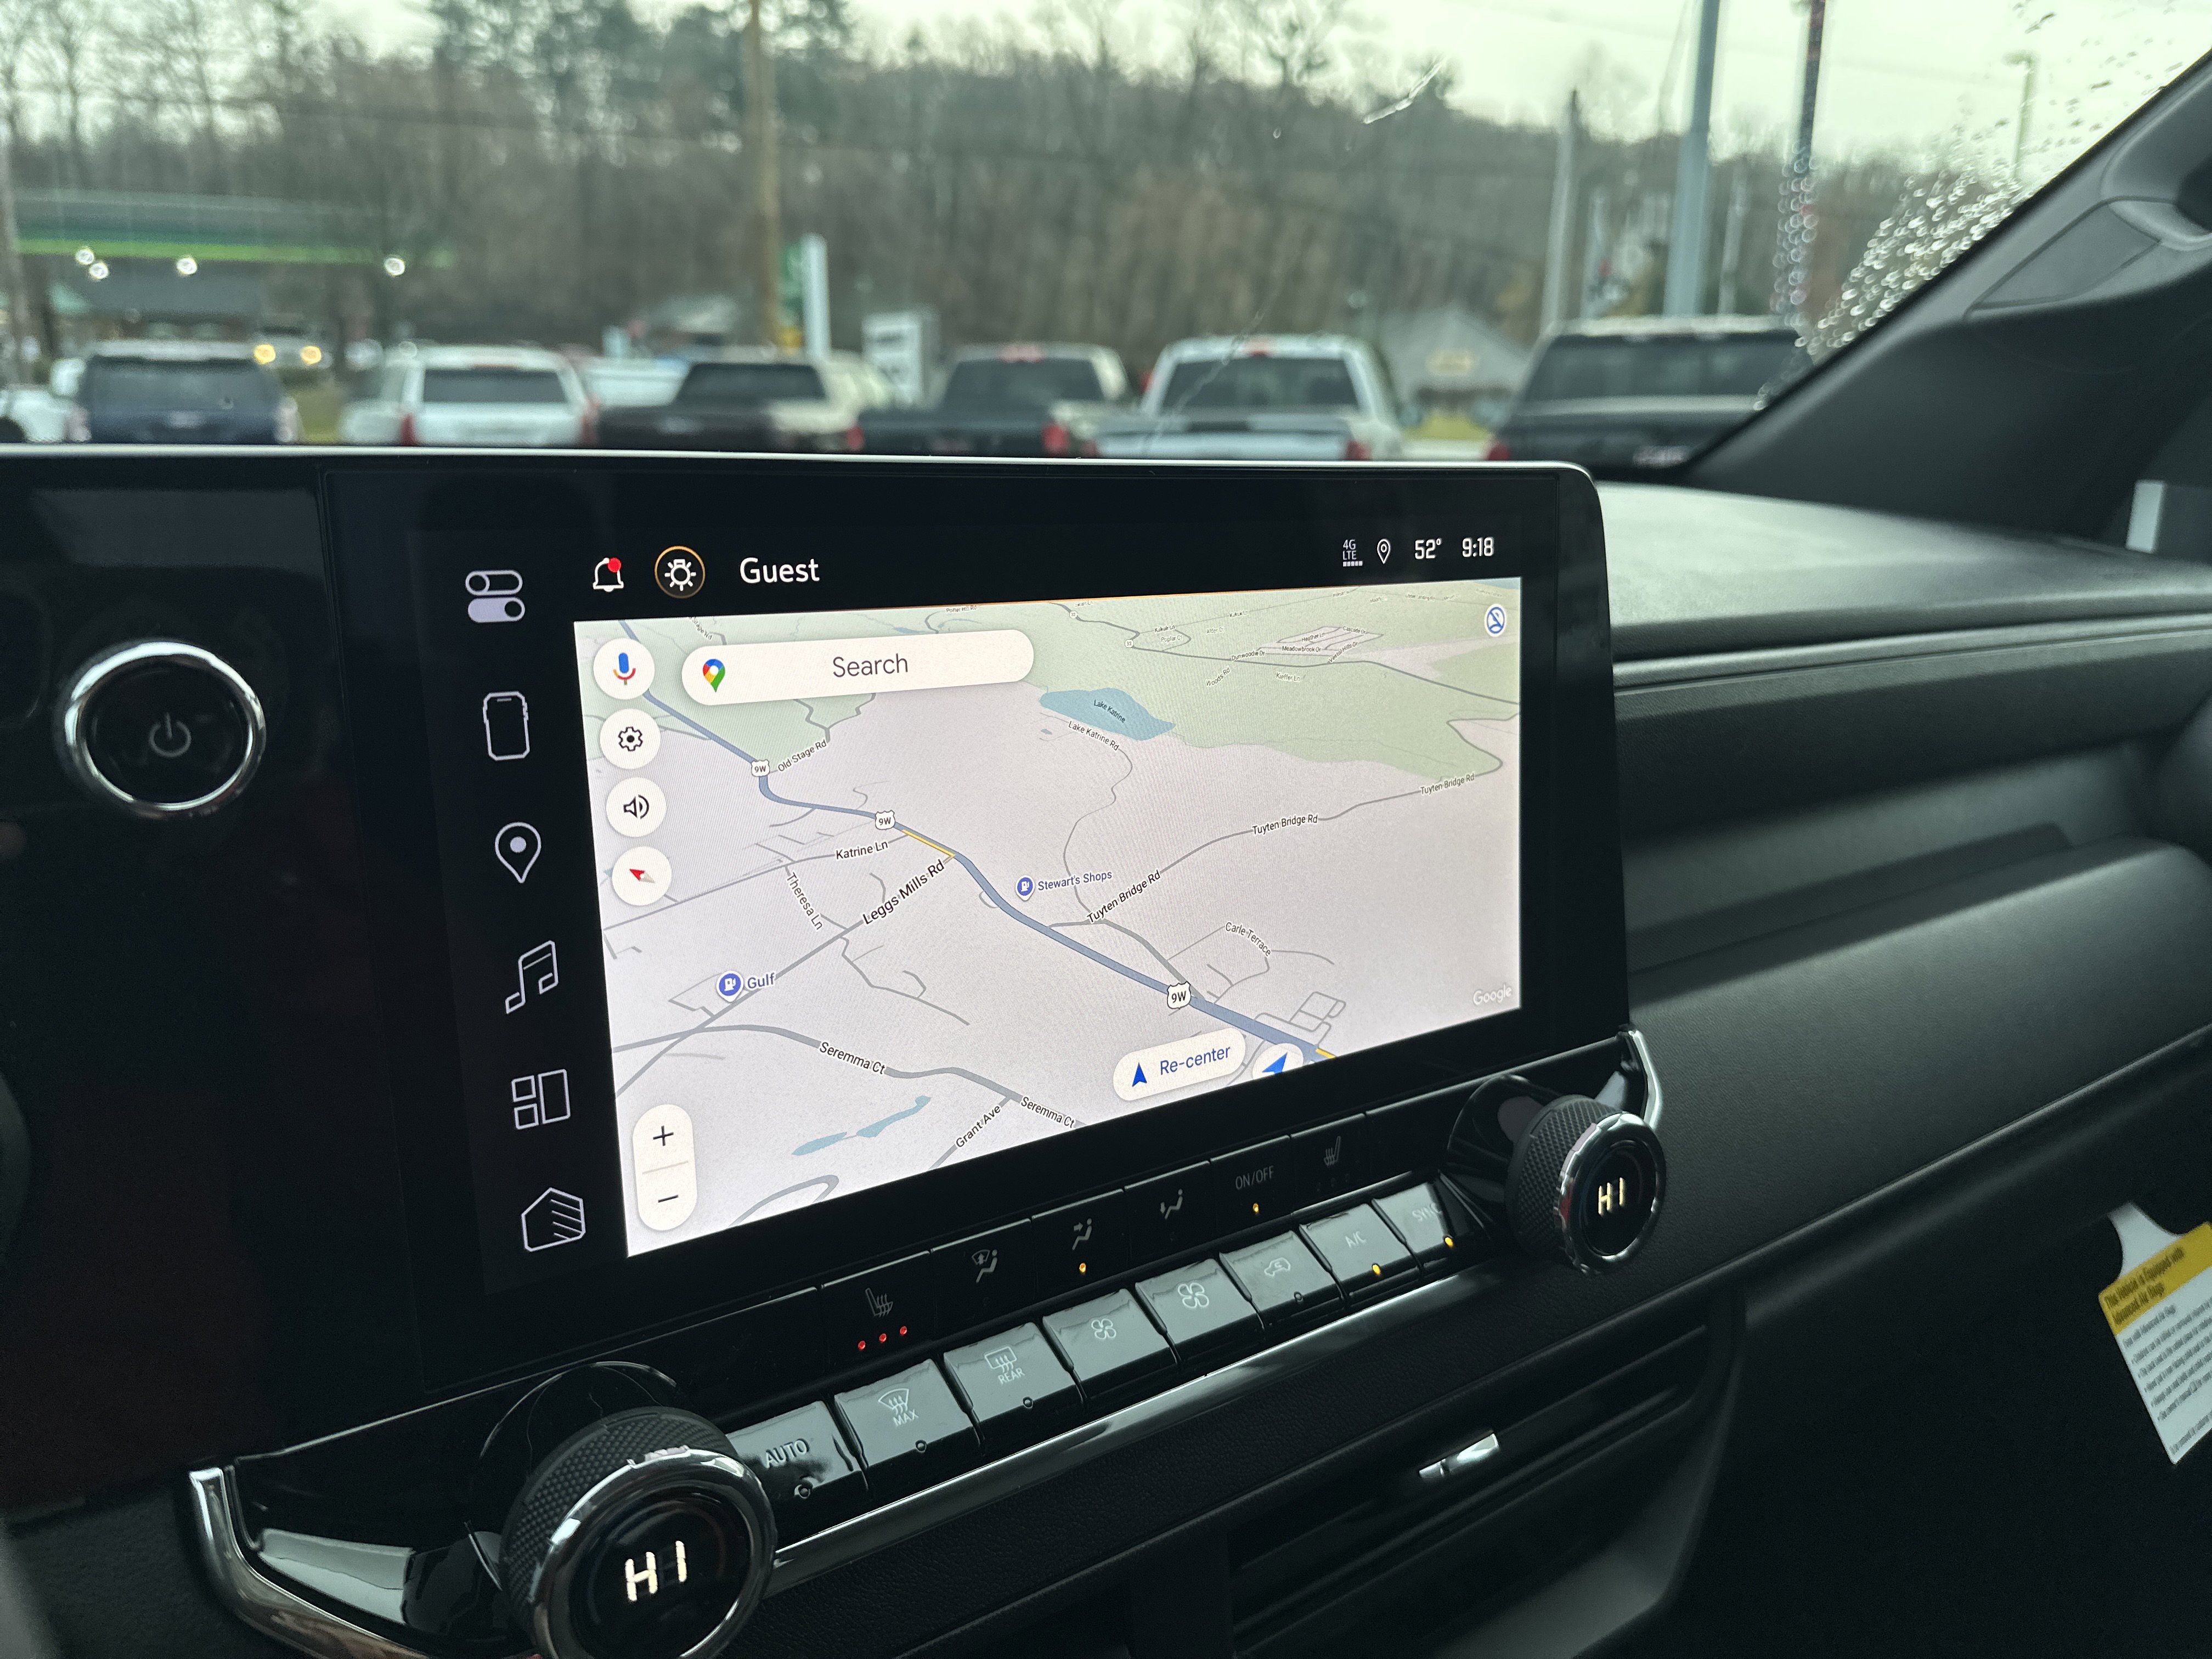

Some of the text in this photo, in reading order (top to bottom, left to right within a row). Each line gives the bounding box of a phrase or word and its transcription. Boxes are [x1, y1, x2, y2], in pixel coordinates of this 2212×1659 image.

[1342, 539, 1356, 550] 4G
[1342, 550, 1357, 560] LTE
[1415, 538, 1442, 560] 52°
[1462, 537, 1495, 557] 9:18
[740, 557, 820, 584] Guest
[833, 654, 909, 679] Search
[1231, 651, 1259, 661] Dunwoodie
[1206, 667, 1231, 686] Woods Rd
[1276, 672, 1293, 681] Kieffer
[1094, 699, 1125, 723] Lake Katrine
[1068, 721, 1120, 751] Lake Katrine Rd
[778, 739, 827, 772] Old Stage Rd
[1420, 773, 1475, 794] Tuyten Bridge Rd
[1252, 814, 1318, 834] Tuyten Bridge Rd
[836, 841, 888, 860] Katrine Ln
[862, 859, 945, 924] Leggs Mills Rd
[1038, 871, 1112, 890] Stewart's Shops
[787, 872, 822, 930] Theresa Ln
[1087, 870, 1161, 923] Tuyten Bridge Rd
[1226, 922, 1271, 956] Carle Terrace
[747, 972, 775, 989] Gulf
[1171, 990, 1187, 1003] 9W
[1473, 983, 1512, 1005] Google
[820, 1042, 885, 1074] Seremma Ct
[1160, 1046, 1231, 1075] Re-center
[1021, 1097, 1075, 1128] Seremma Ct
[956, 1105, 1001, 1148] Grant Ave
[1235, 1165, 1274, 1190] ON/OFF
[1598, 1177, 1625, 1215] HI
[1345, 1231, 1367, 1249] A/C
[997, 1367, 1025, 1384] REAR
[893, 1409, 919, 1426] MAX
[765, 1438, 810, 1469] AUTO
[625, 1541, 687, 1601] HI
